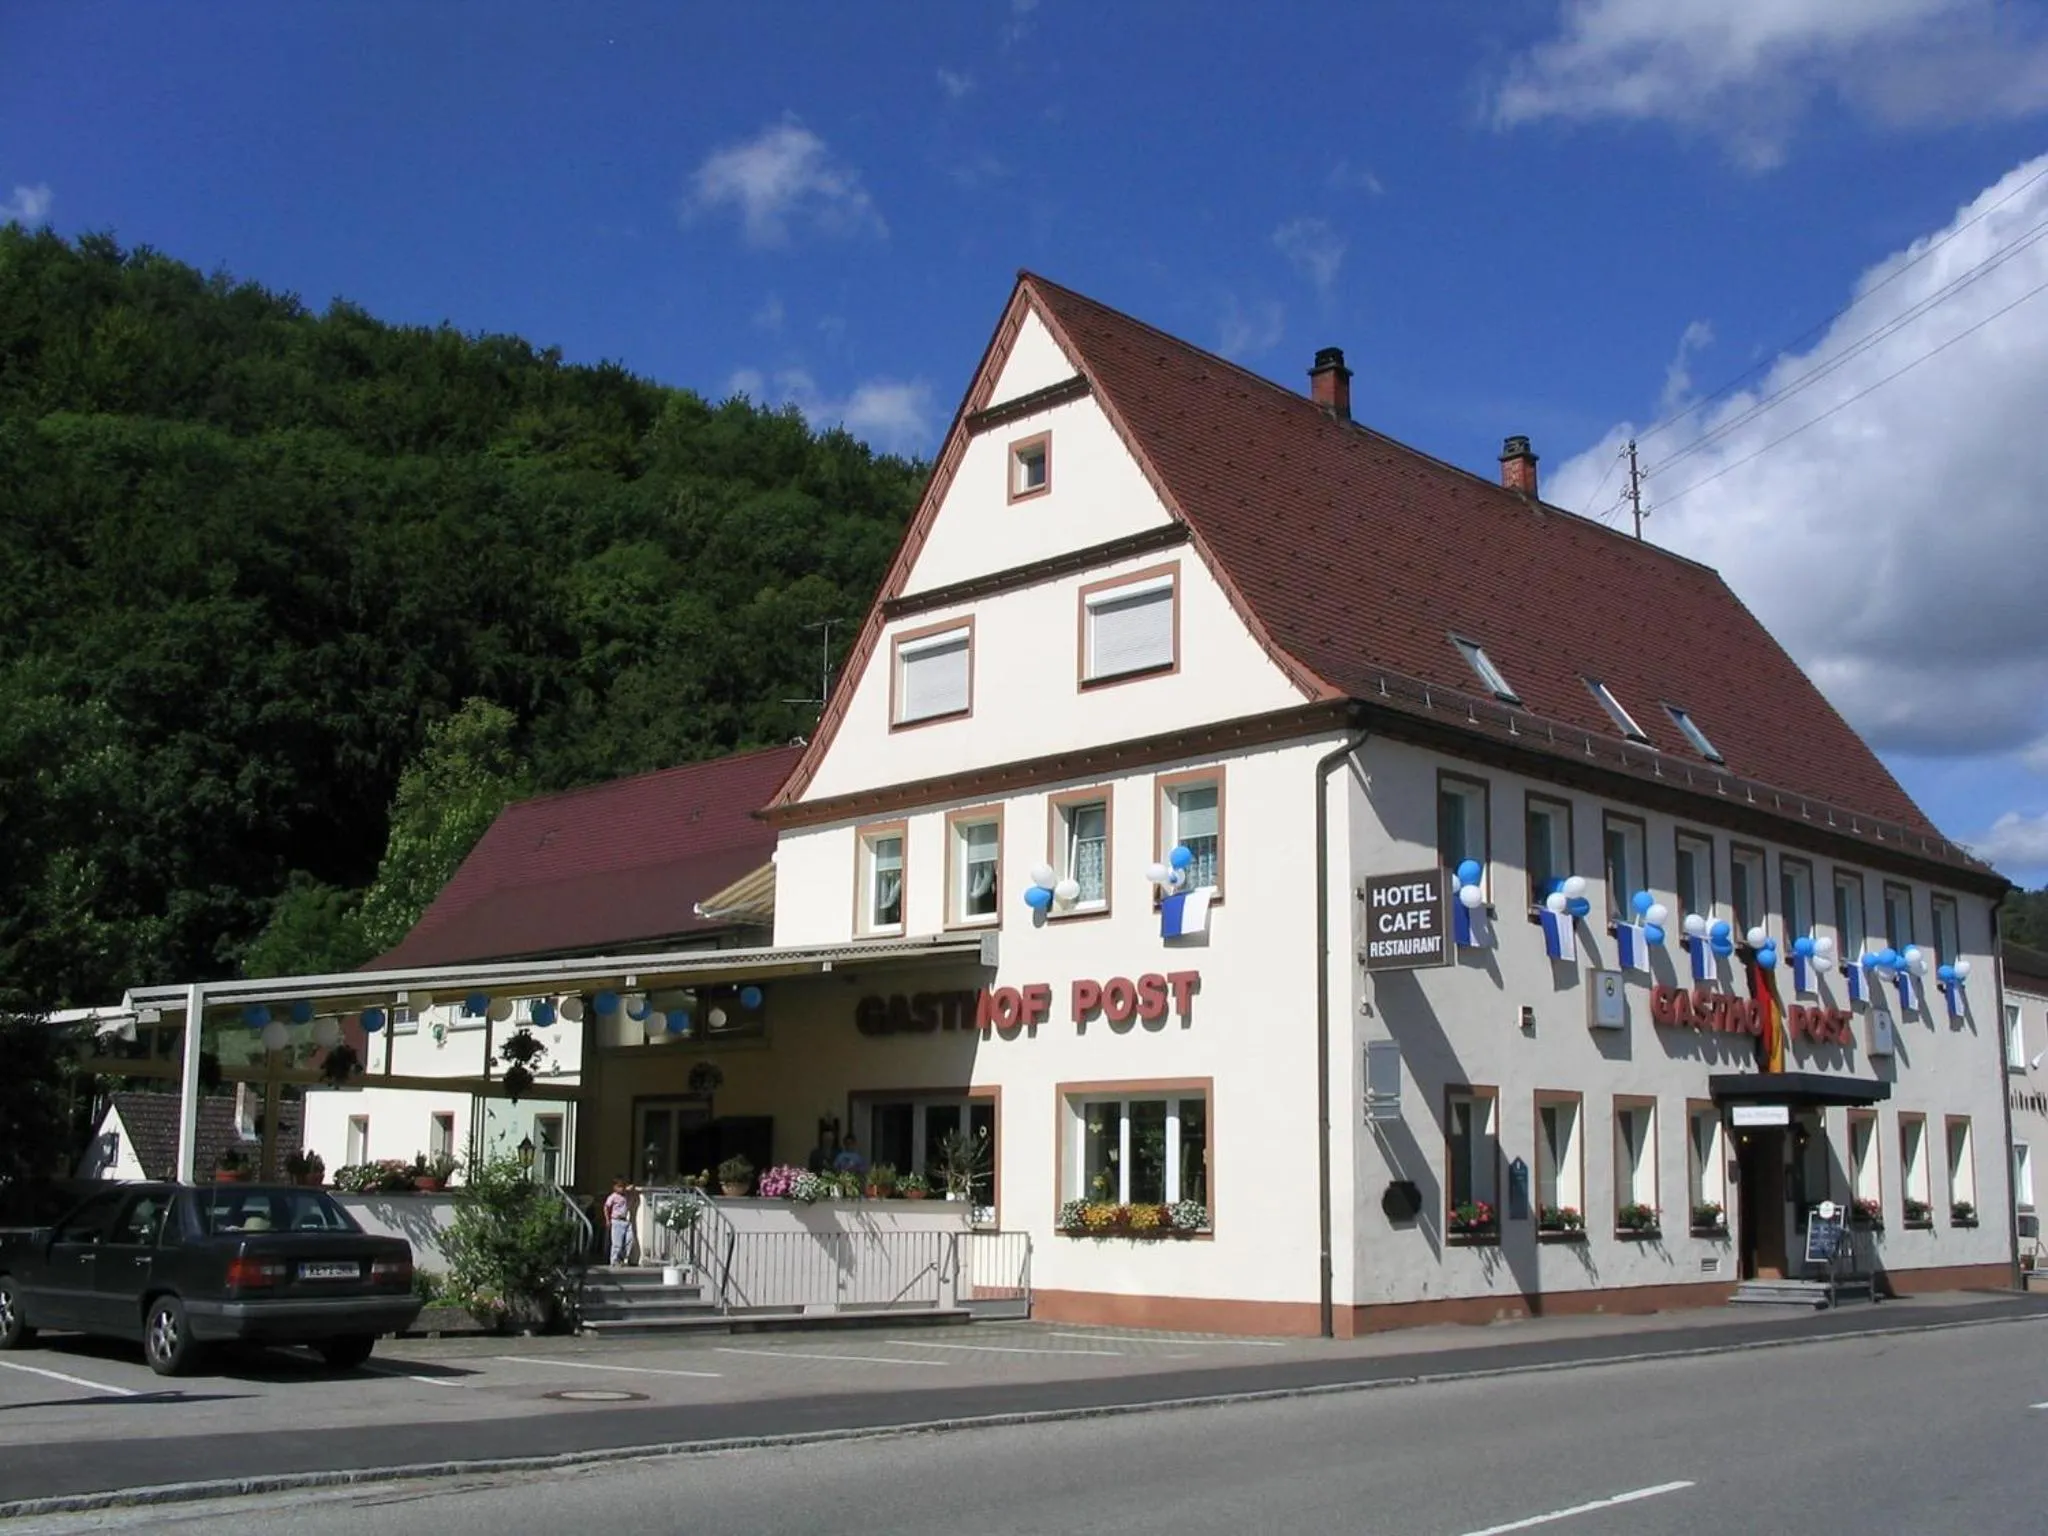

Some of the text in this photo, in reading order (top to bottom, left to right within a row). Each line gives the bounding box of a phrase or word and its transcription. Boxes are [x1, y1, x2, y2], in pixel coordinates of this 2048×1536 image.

[1373, 883, 1437, 907] HOTEL
[1379, 910, 1431, 933] CAFE
[1370, 936, 1441, 957] RESTAURANT
[856, 970, 1199, 1036] GASTHOF POST
[1650, 985, 1853, 1045] GASTHO POST
